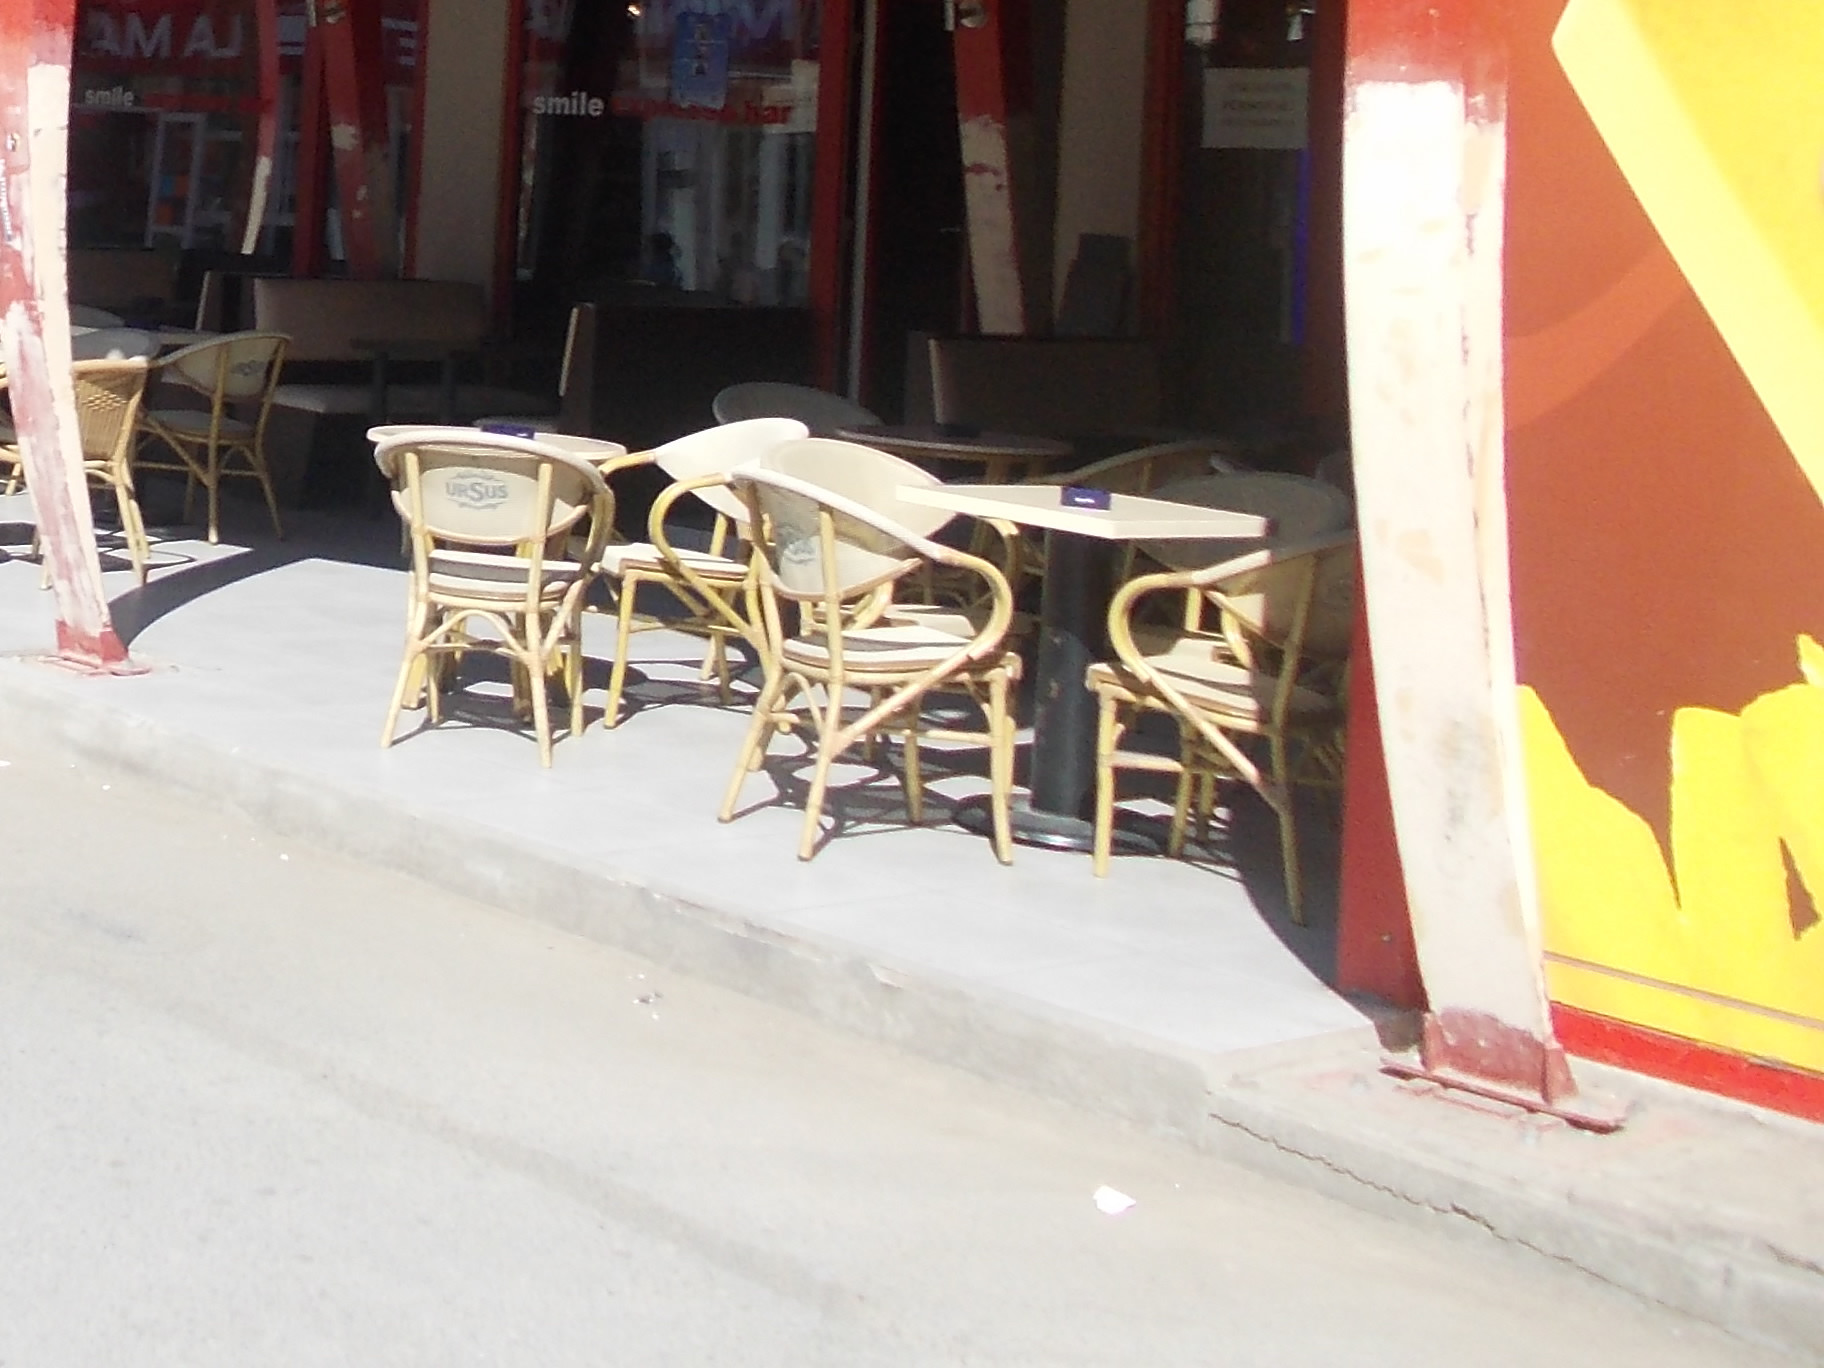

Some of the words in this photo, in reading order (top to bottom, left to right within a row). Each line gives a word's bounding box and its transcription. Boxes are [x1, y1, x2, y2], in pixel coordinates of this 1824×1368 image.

[84, 85, 135, 107] smile
[533, 91, 605, 117] smile
[445, 482, 509, 502] URSUS
